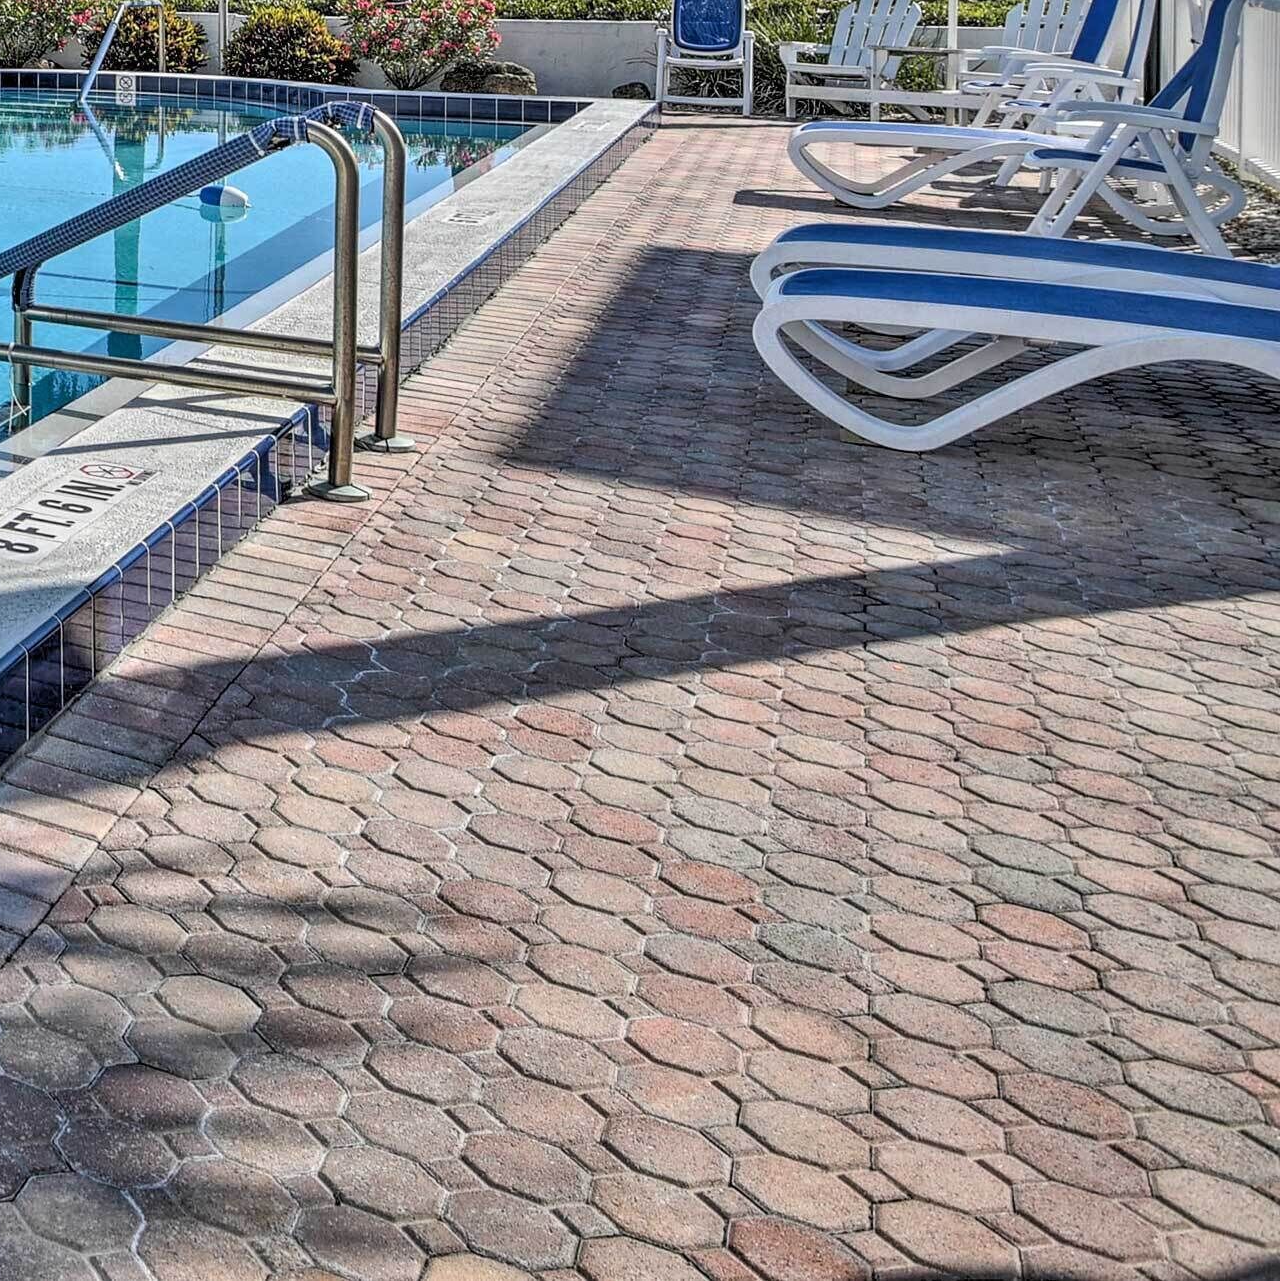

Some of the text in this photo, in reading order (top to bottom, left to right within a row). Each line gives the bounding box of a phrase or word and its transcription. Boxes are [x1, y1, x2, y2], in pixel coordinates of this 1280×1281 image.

[54, 479, 125, 502] IN.
[38, 499, 93, 514] 6
[0, 512, 76, 538] FT.
